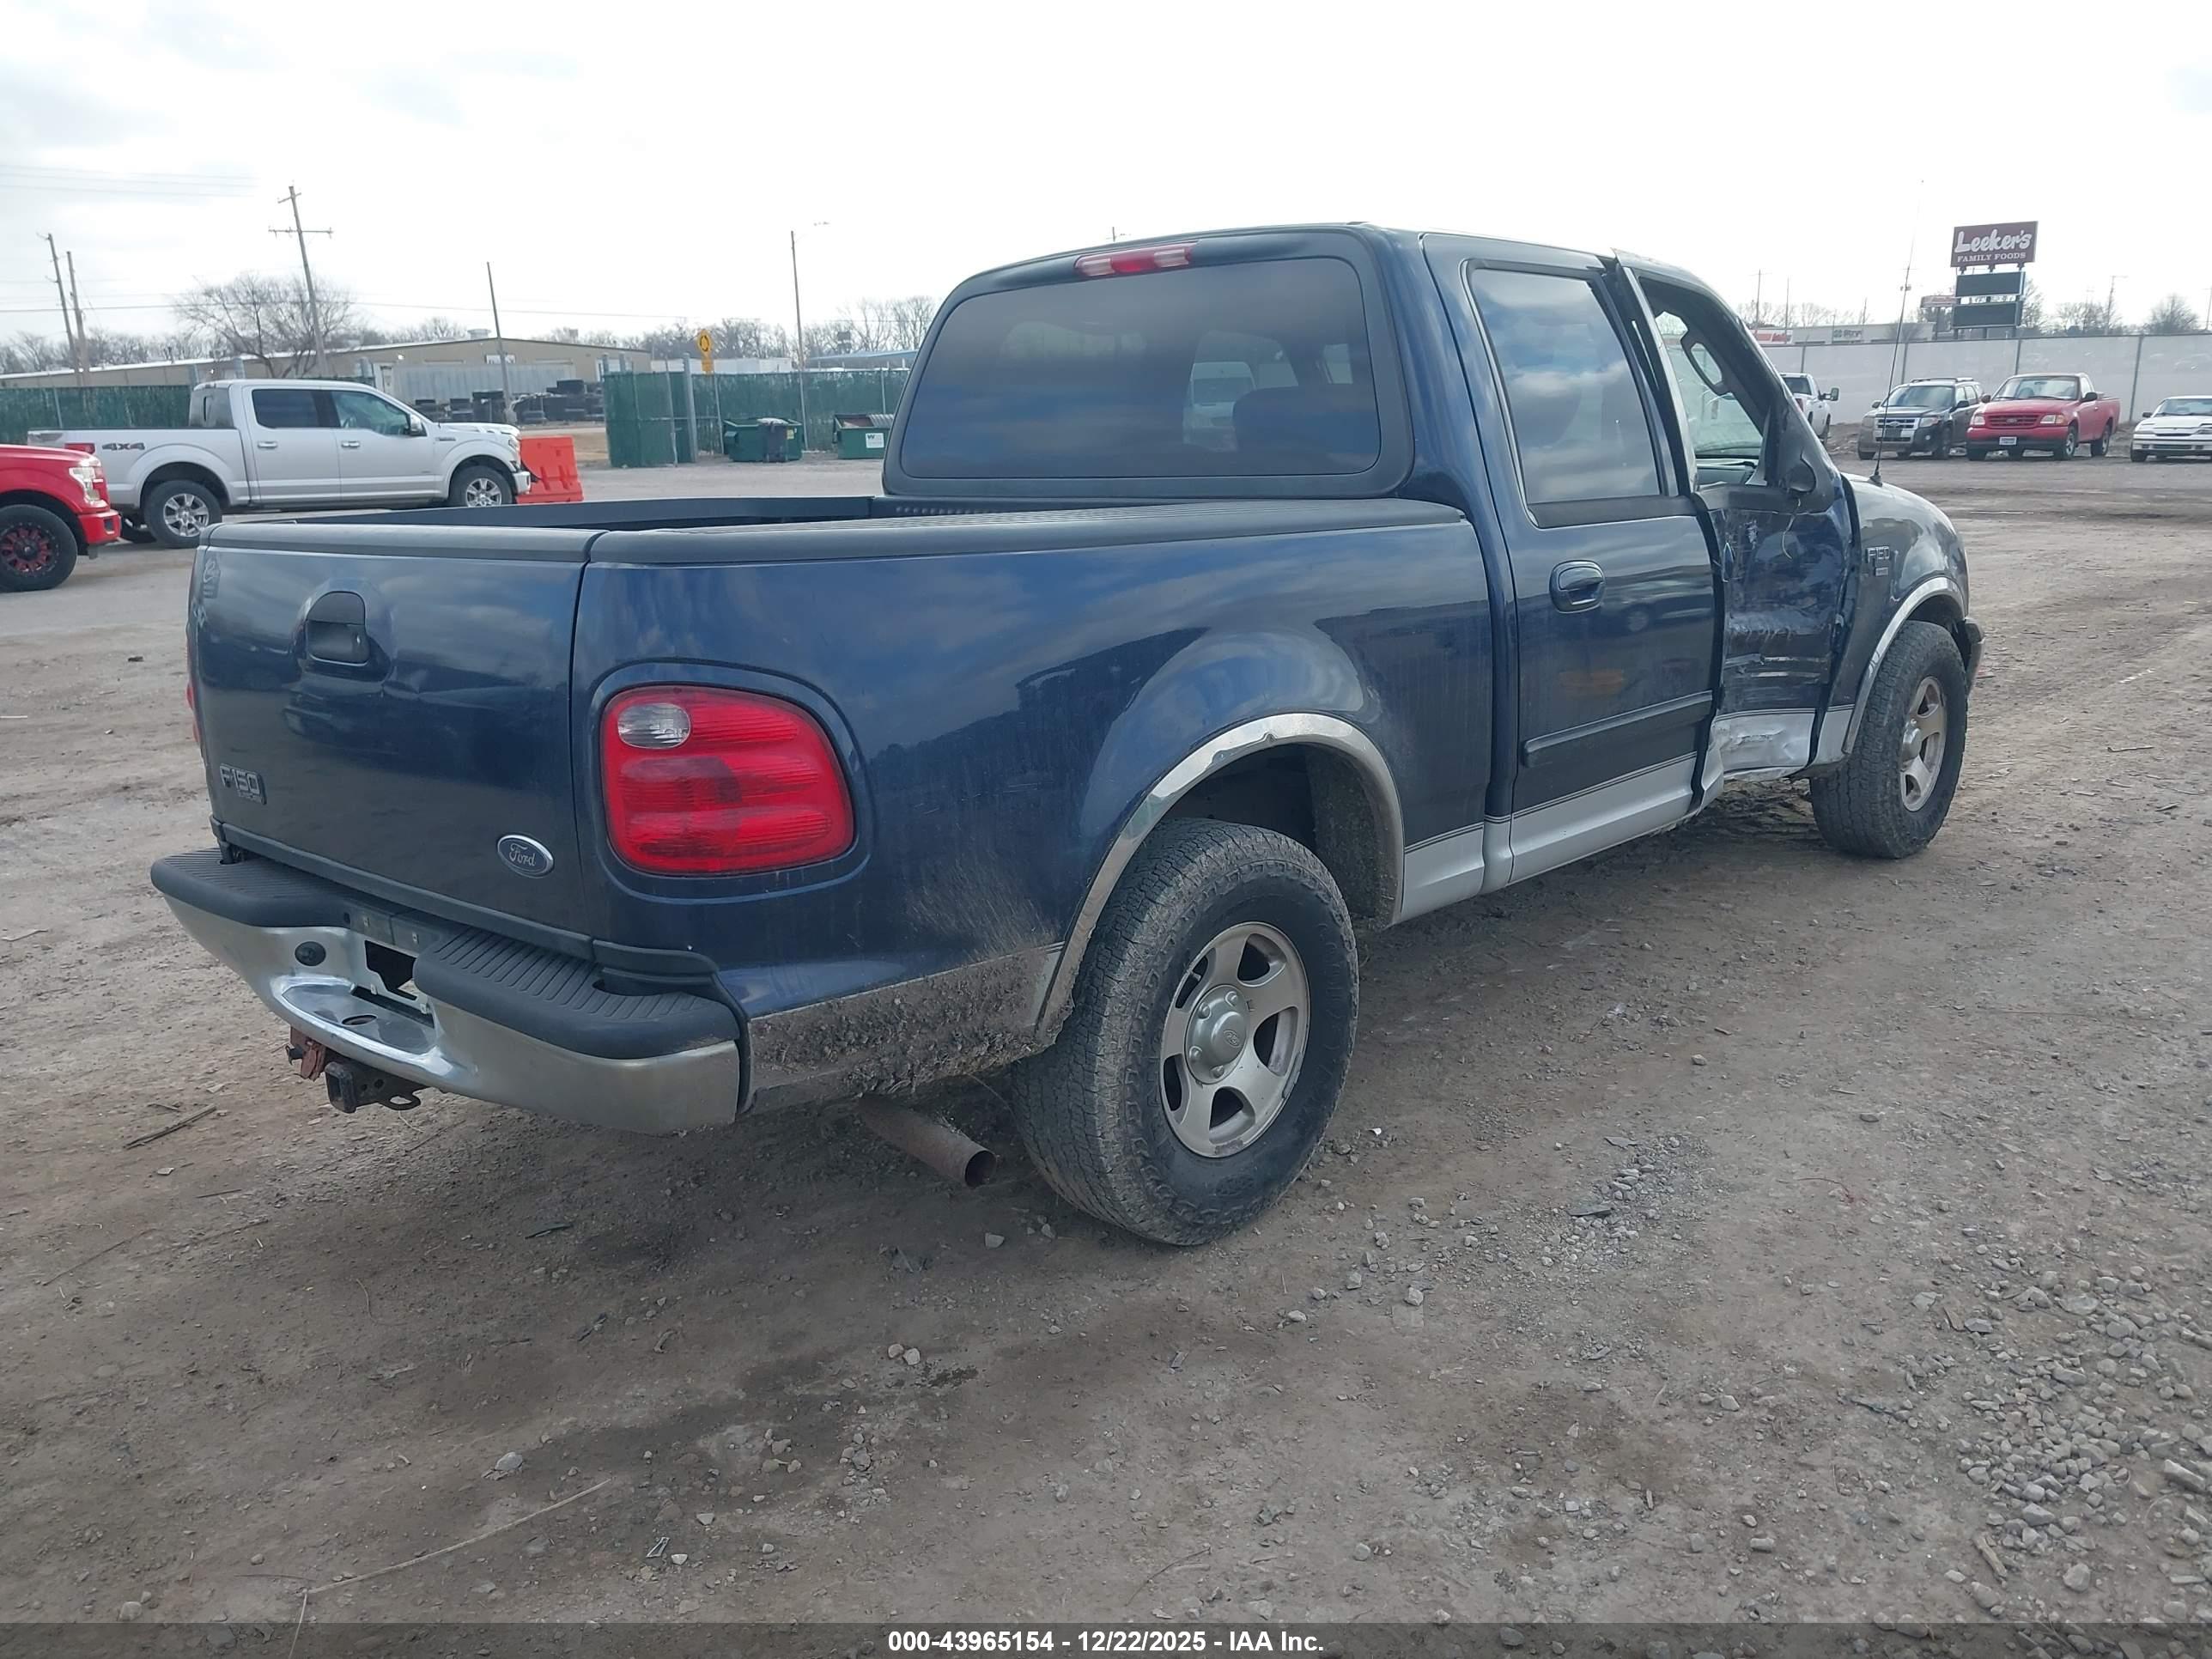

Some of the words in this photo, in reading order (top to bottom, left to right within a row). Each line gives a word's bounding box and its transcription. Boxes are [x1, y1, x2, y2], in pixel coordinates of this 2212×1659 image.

[1954, 228, 2033, 253] Leeker's
[1957, 254, 1992, 263] FAMILY
[1994, 252, 2027, 260] FOODS
